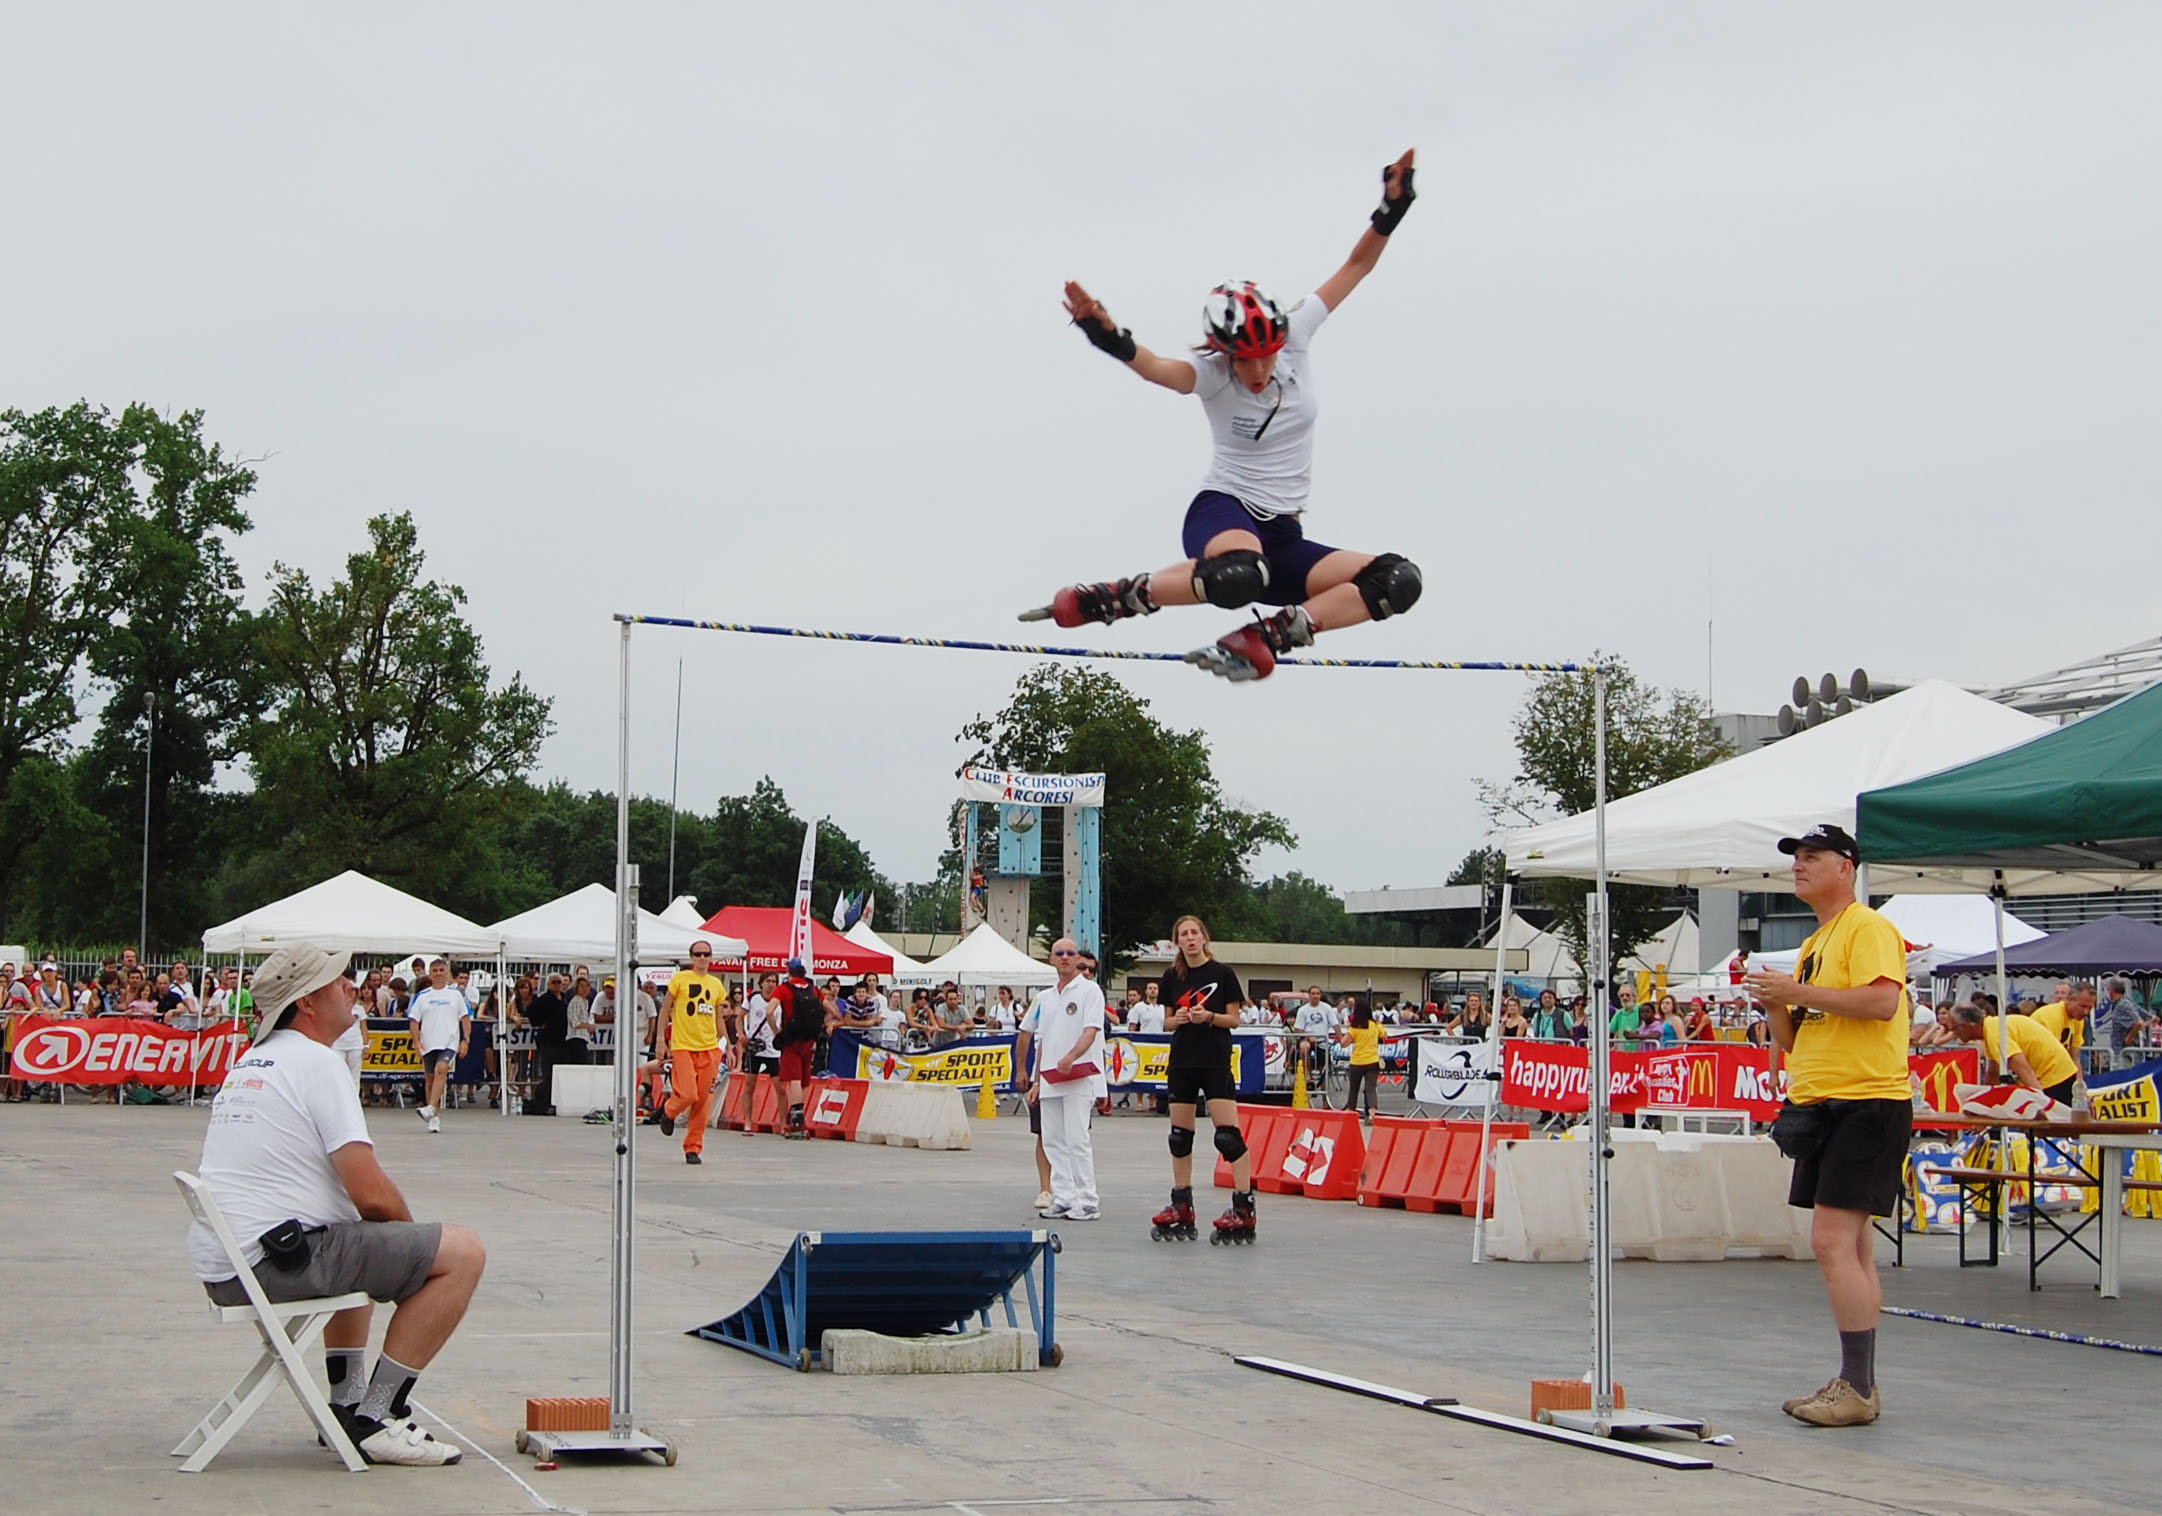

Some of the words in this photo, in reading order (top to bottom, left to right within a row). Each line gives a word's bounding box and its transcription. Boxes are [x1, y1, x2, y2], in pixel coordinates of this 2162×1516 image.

[1002, 787, 1074, 804] ARCORESI
[750, 957, 778, 968] FREE
[84, 1032, 248, 1073] ENERVIT
